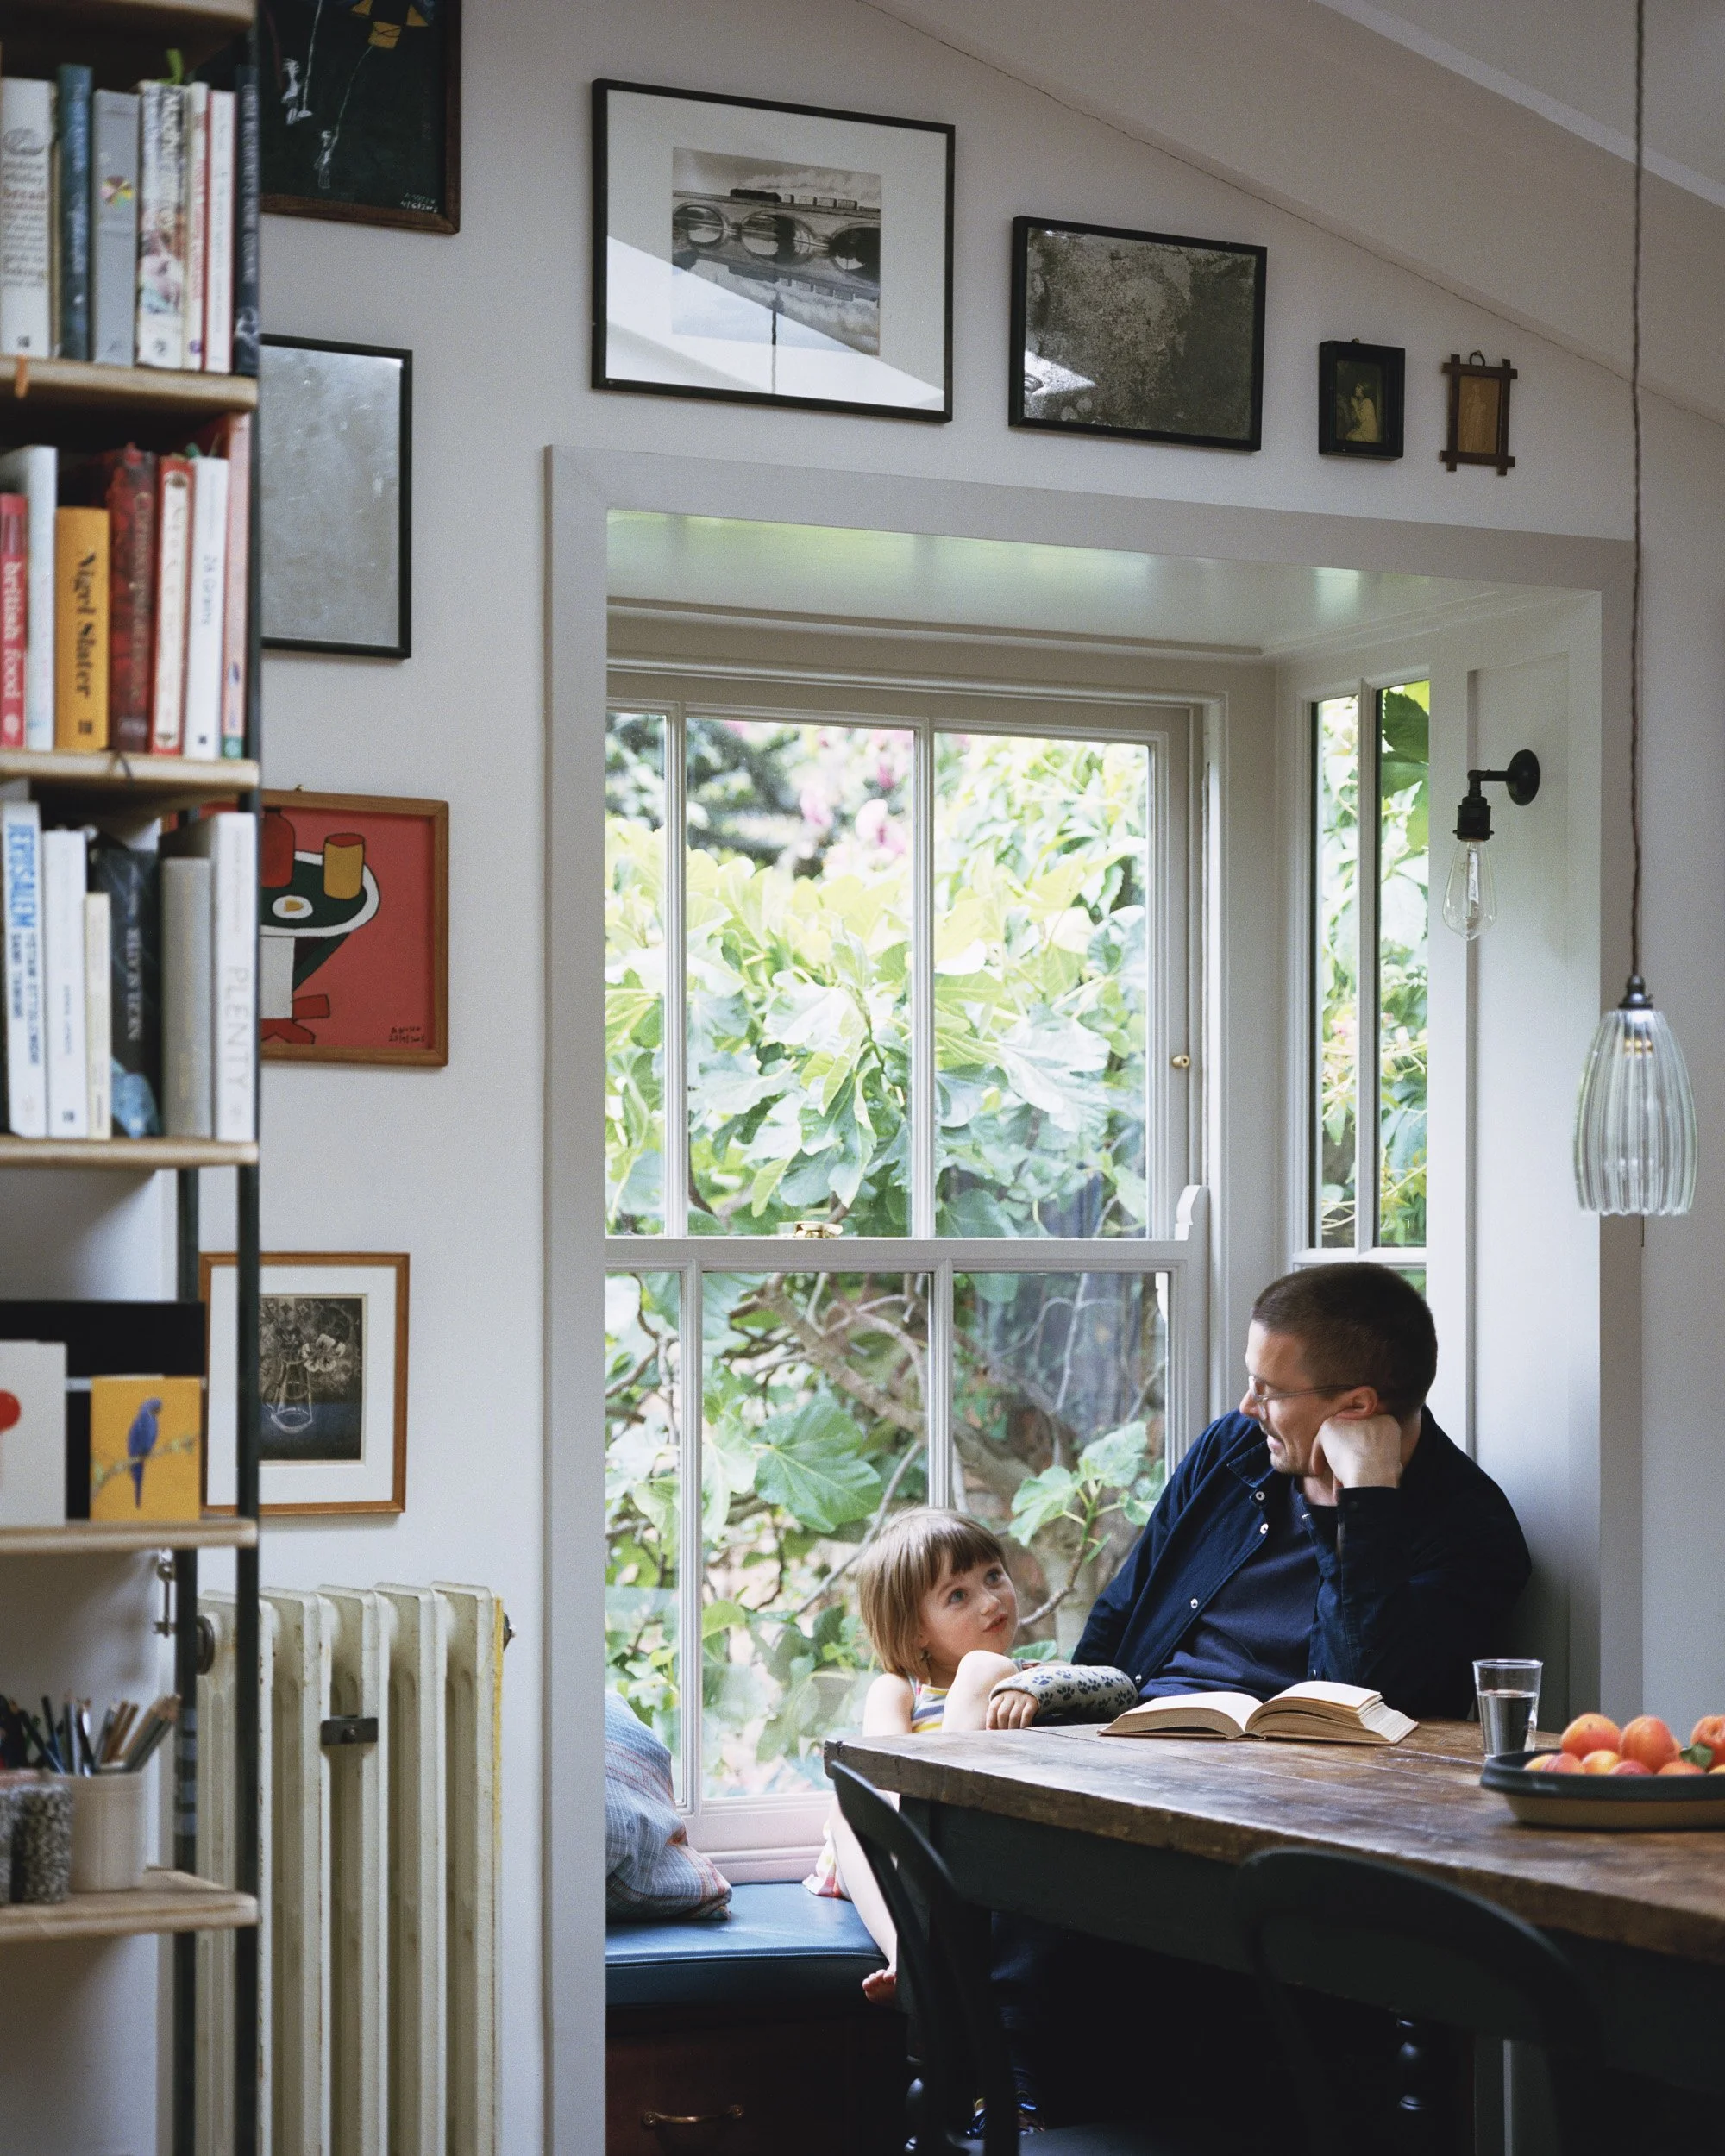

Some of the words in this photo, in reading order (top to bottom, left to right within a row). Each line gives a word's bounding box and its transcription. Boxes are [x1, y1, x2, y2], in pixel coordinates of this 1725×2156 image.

[3, 561, 22, 641] british
[73, 553, 97, 615] Nigel
[3, 649, 22, 699] food
[77, 623, 97, 699] Slater
[8, 824, 36, 929] JERUSALEM
[224, 966, 249, 1090] PLENTY
